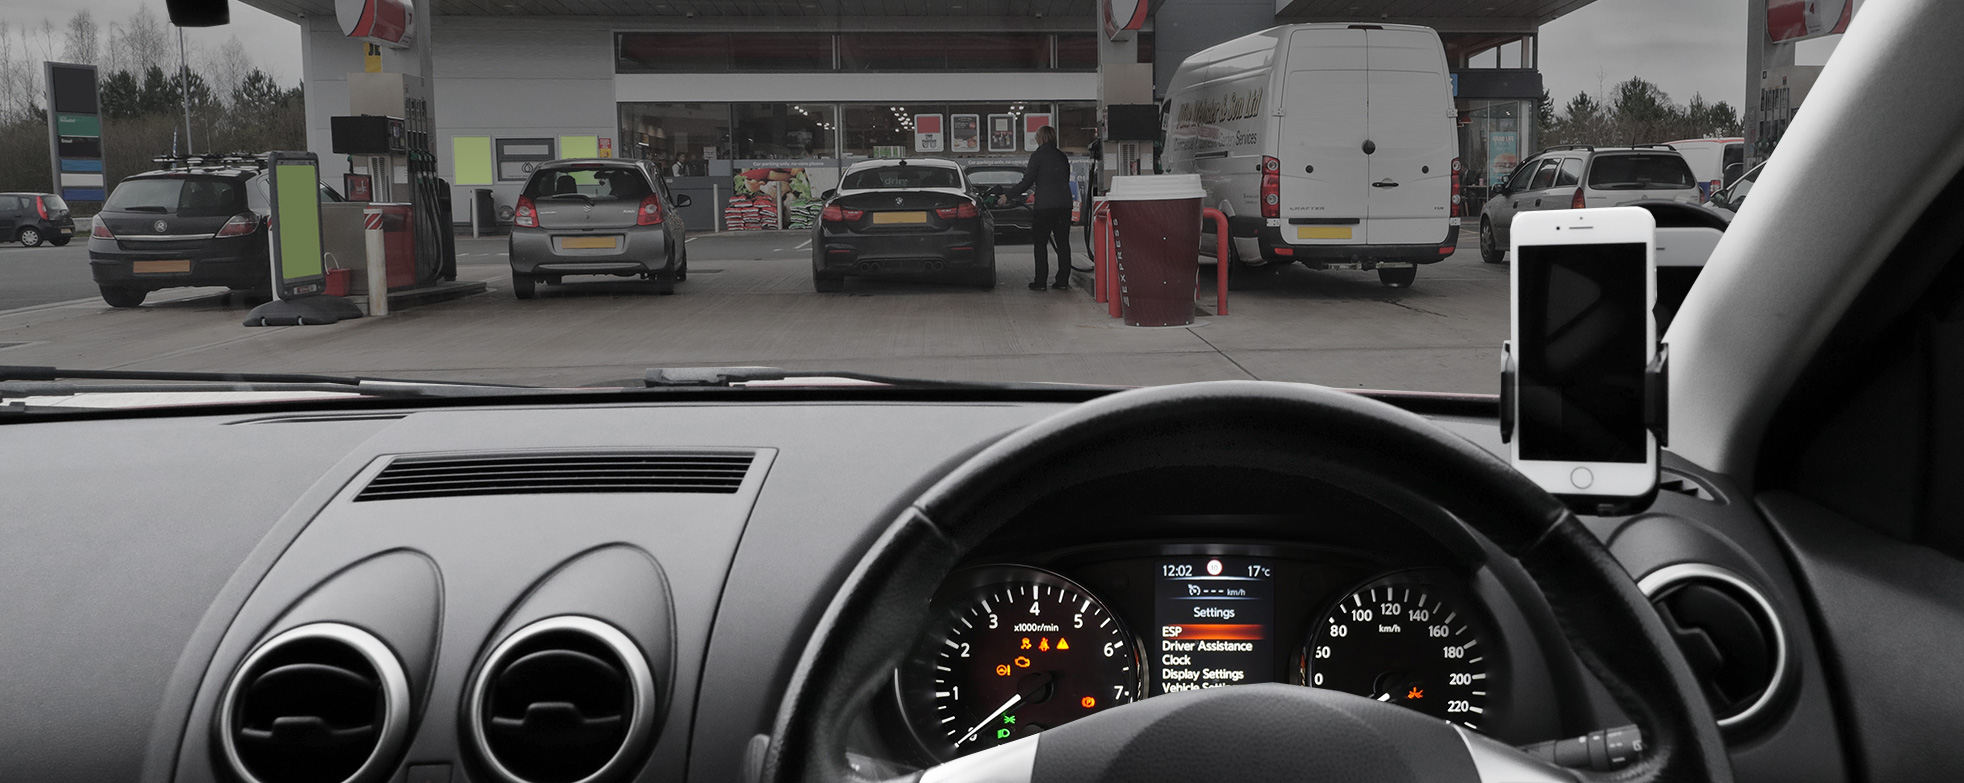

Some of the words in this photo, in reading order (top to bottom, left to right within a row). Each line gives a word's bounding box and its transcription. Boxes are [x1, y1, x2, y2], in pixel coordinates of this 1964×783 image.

[1809, 2, 1816, 15] 4
[1244, 87, 1264, 119] Ltd
[1236, 130, 1257, 146] Services
[1162, 564, 1193, 577] 12:02
[1227, 588, 1246, 596] km/h
[1030, 601, 1040, 616] 4
[1193, 606, 1236, 620] Settings
[1351, 609, 1373, 622] 100
[1380, 602, 1401, 616] 120
[1408, 609, 1430, 622] 140
[988, 614, 999, 629] 3
[1013, 622, 1060, 633] x1000r/min
[1073, 613, 1084, 629] 5
[1162, 626, 1183, 638] ESP
[1329, 624, 1348, 638] 80
[1378, 624, 1401, 633] km/h
[1428, 624, 1450, 638] 160
[960, 642, 971, 658] 2
[1103, 643, 1115, 658] 6
[1162, 641, 1195, 651] Driver
[1197, 640, 1254, 651] Assistance
[1443, 645, 1465, 659] 180
[1162, 654, 1191, 666] Clock
[1162, 669, 1200, 682] Display
[1202, 668, 1245, 681] Settings
[1314, 672, 1324, 686] 0
[1449, 672, 1472, 686] 200
[952, 685, 959, 701] 1
[1113, 685, 1124, 700] 7
[1162, 682, 1199, 693] Vehicle
[1447, 699, 1470, 713] 220
